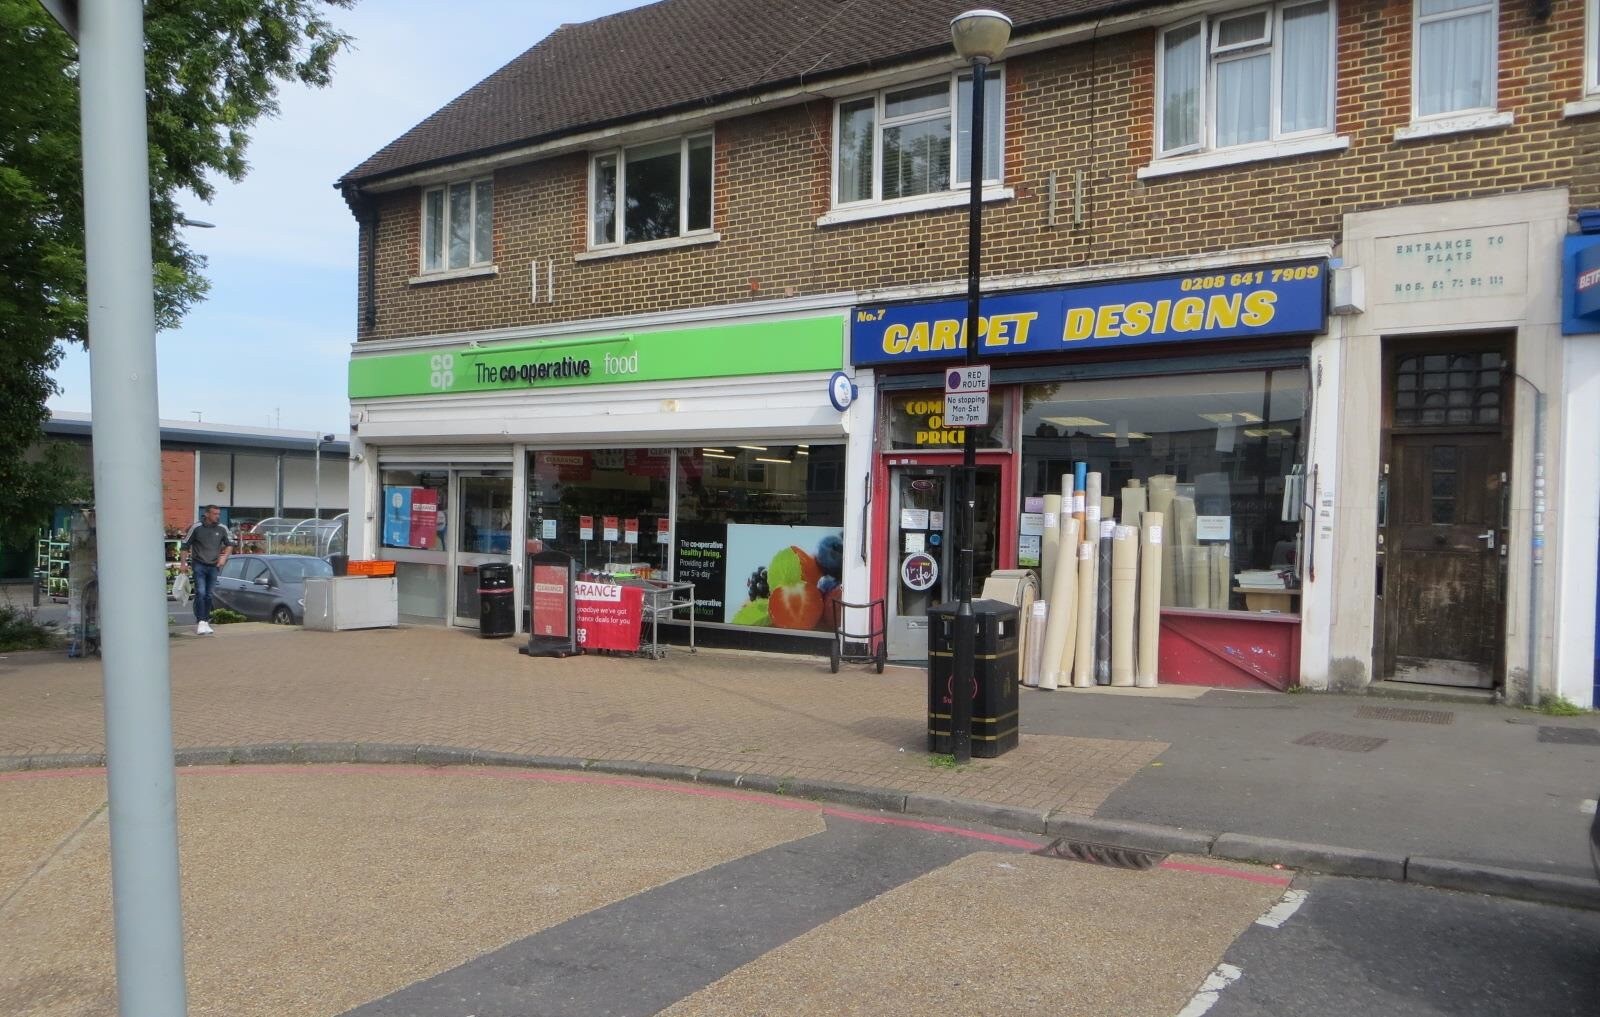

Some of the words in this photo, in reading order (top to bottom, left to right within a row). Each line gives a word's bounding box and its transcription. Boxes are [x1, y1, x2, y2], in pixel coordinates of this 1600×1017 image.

[1396, 239, 1472, 254] ENTRANCE
[1488, 236, 1504, 245] TO
[1426, 252, 1472, 263] FLATS
[1180, 275, 1226, 292] 0208
[1231, 271, 1264, 286] 641
[1271, 266, 1320, 282] 7909
[857, 309, 886, 322] No.7
[882, 312, 1038, 354] CARPET
[1062, 290, 1278, 342] DESIGNS
[475, 362, 498, 383] The
[604, 352, 638, 375] food
[968, 371, 982, 379] RED
[962, 380, 986, 388] ROUTE
[958, 396, 986, 404] stopping
[680, 548, 701, 558] healthy
[680, 559, 702, 568] Providing
[576, 584, 617, 598] ARANCE
